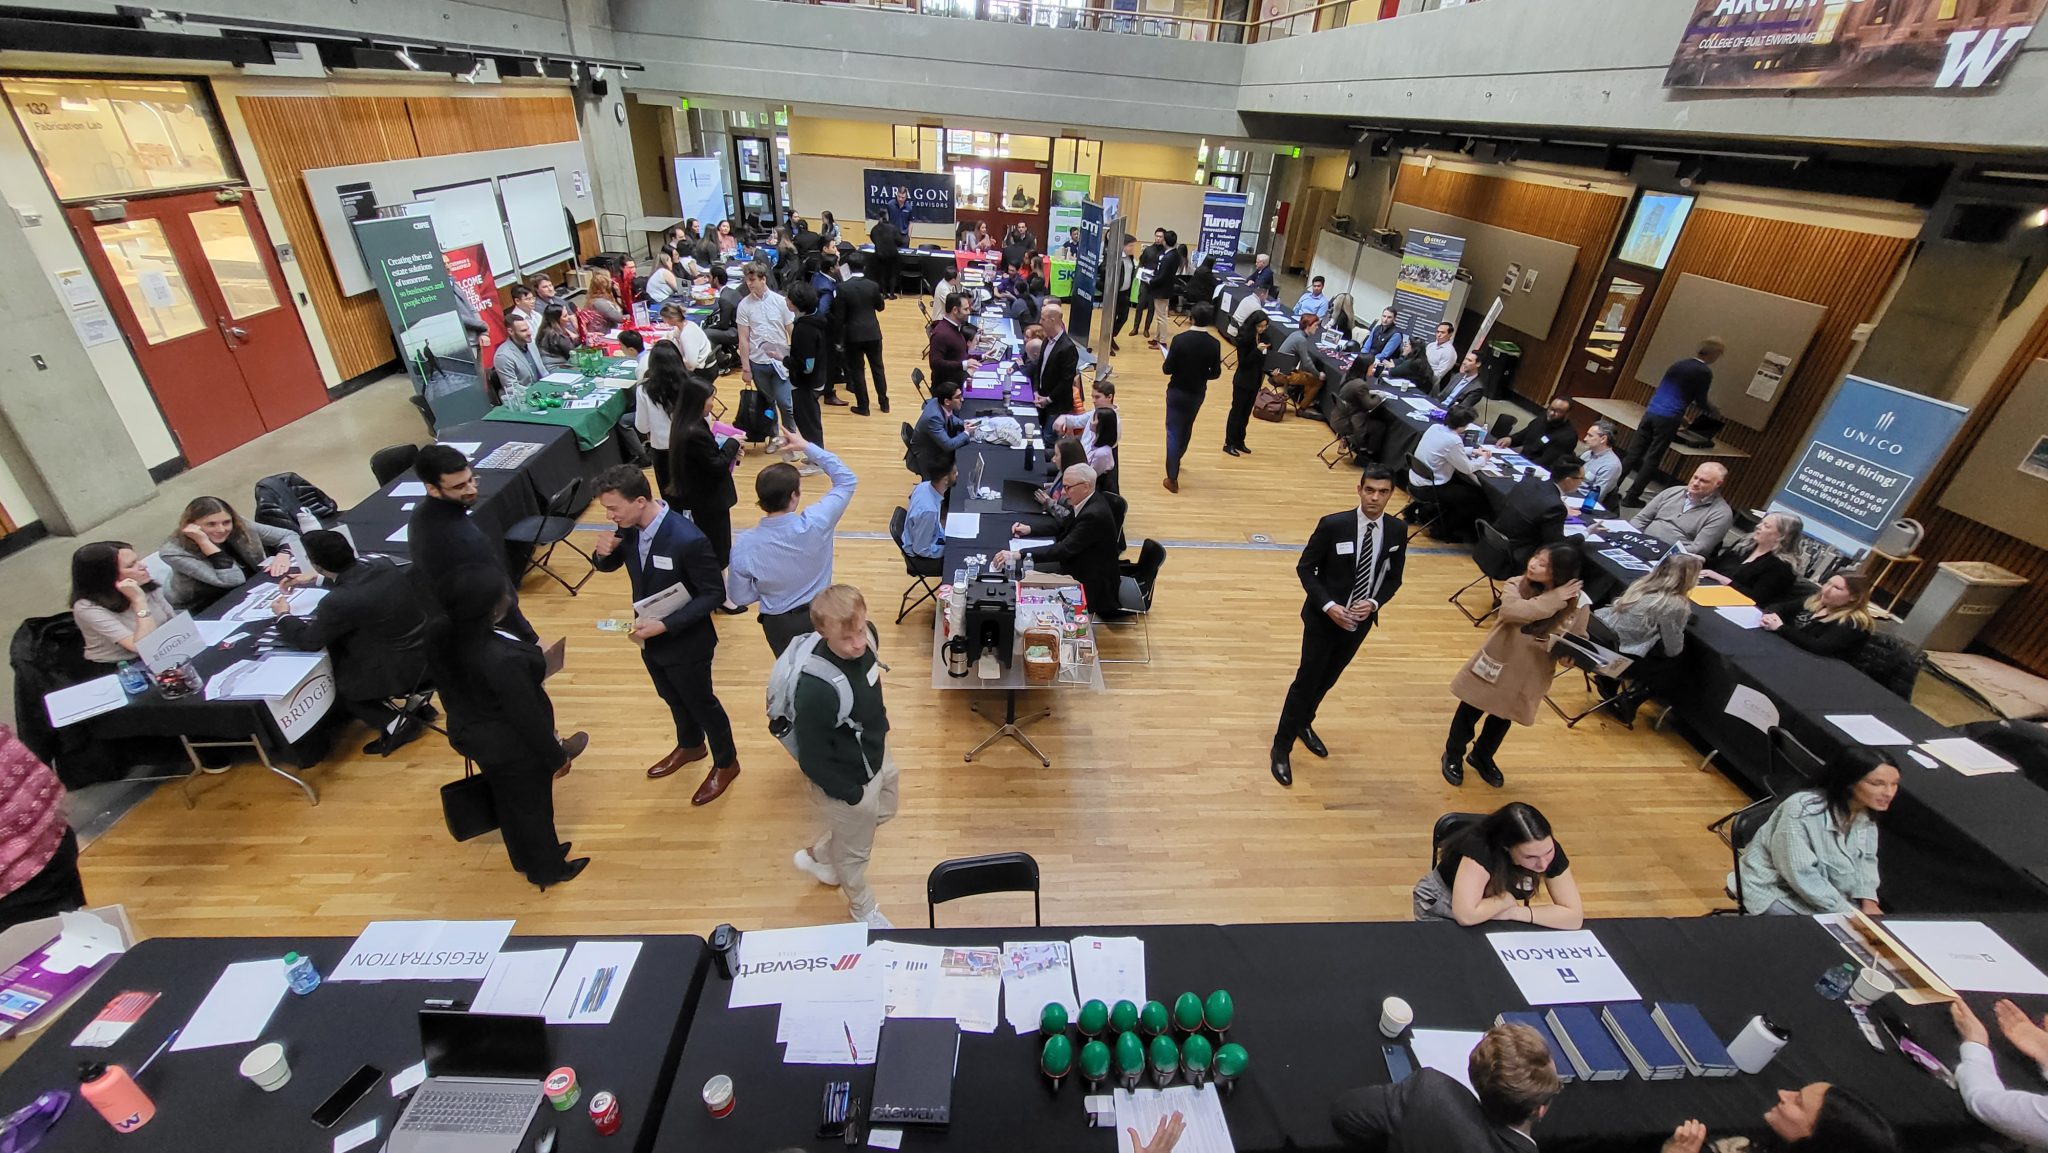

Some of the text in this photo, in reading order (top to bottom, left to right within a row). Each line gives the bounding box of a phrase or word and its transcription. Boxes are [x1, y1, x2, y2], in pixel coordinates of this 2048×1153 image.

[1699, 37, 1733, 49] COLLEGE
[1732, 37, 1745, 48] OF
[1744, 35, 1767, 47] BUILT
[1933, 26, 2033, 88] W
[26, 102, 51, 115] 132
[34, 121, 103, 131] Fabrication Lab
[870, 185, 949, 201] PARAGON
[1203, 213, 1241, 229] Turner
[1210, 238, 1231, 249] Living
[387, 251, 433, 267] Creating the real
[391, 263, 433, 277] estate solutions
[395, 279, 402, 287] of
[406, 285, 434, 296] businesses
[434, 281, 445, 290] and
[455, 274, 483, 289] LCOME
[403, 294, 437, 310] people thrive
[1843, 427, 1903, 455] UNICO
[1817, 449, 1898, 488] We are hiring!
[1804, 466, 1824, 479] Come
[1825, 475, 1846, 488] work
[1847, 484, 1860, 494] for
[1859, 490, 1876, 500] one
[1798, 473, 1882, 513] Washington's TOP 100
[1801, 484, 1868, 517] Best Workplaces!
[1622, 534, 1660, 553] UNICO
[350, 951, 489, 967] REGISTRATION
[1500, 946, 1606, 961] TARRAGON
[740, 956, 829, 978] stewart
[872, 1103, 947, 1120] stewart
